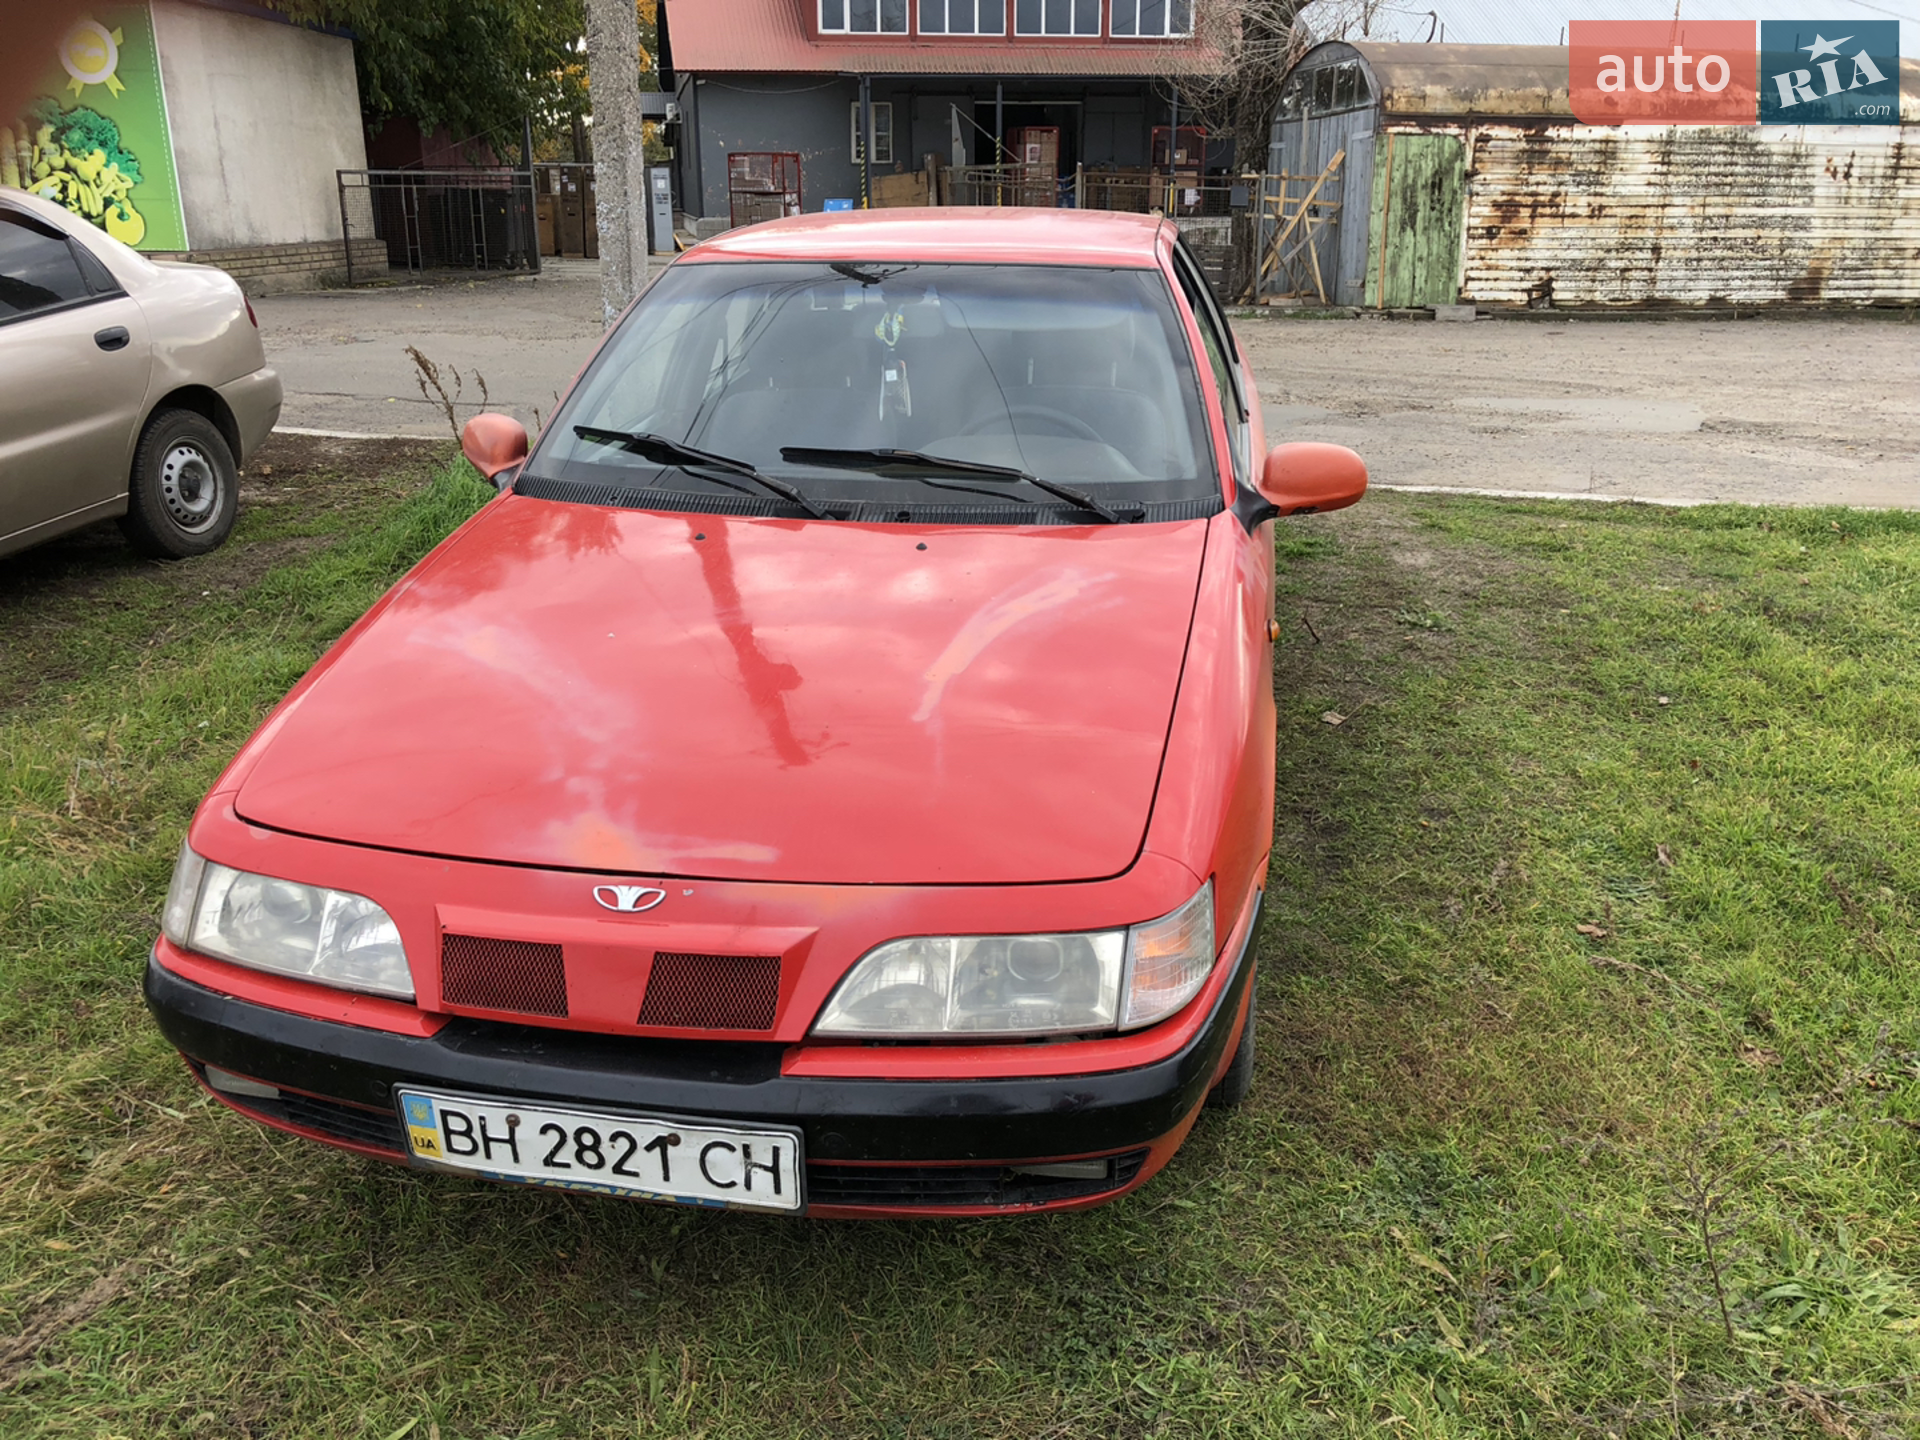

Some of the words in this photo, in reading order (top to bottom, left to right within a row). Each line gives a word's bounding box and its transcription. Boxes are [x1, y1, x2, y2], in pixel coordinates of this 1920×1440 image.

[414, 1135, 437, 1151] UA
[439, 1108, 520, 1164] BH
[539, 1122, 674, 1182] 2821
[700, 1140, 783, 1195] CH
